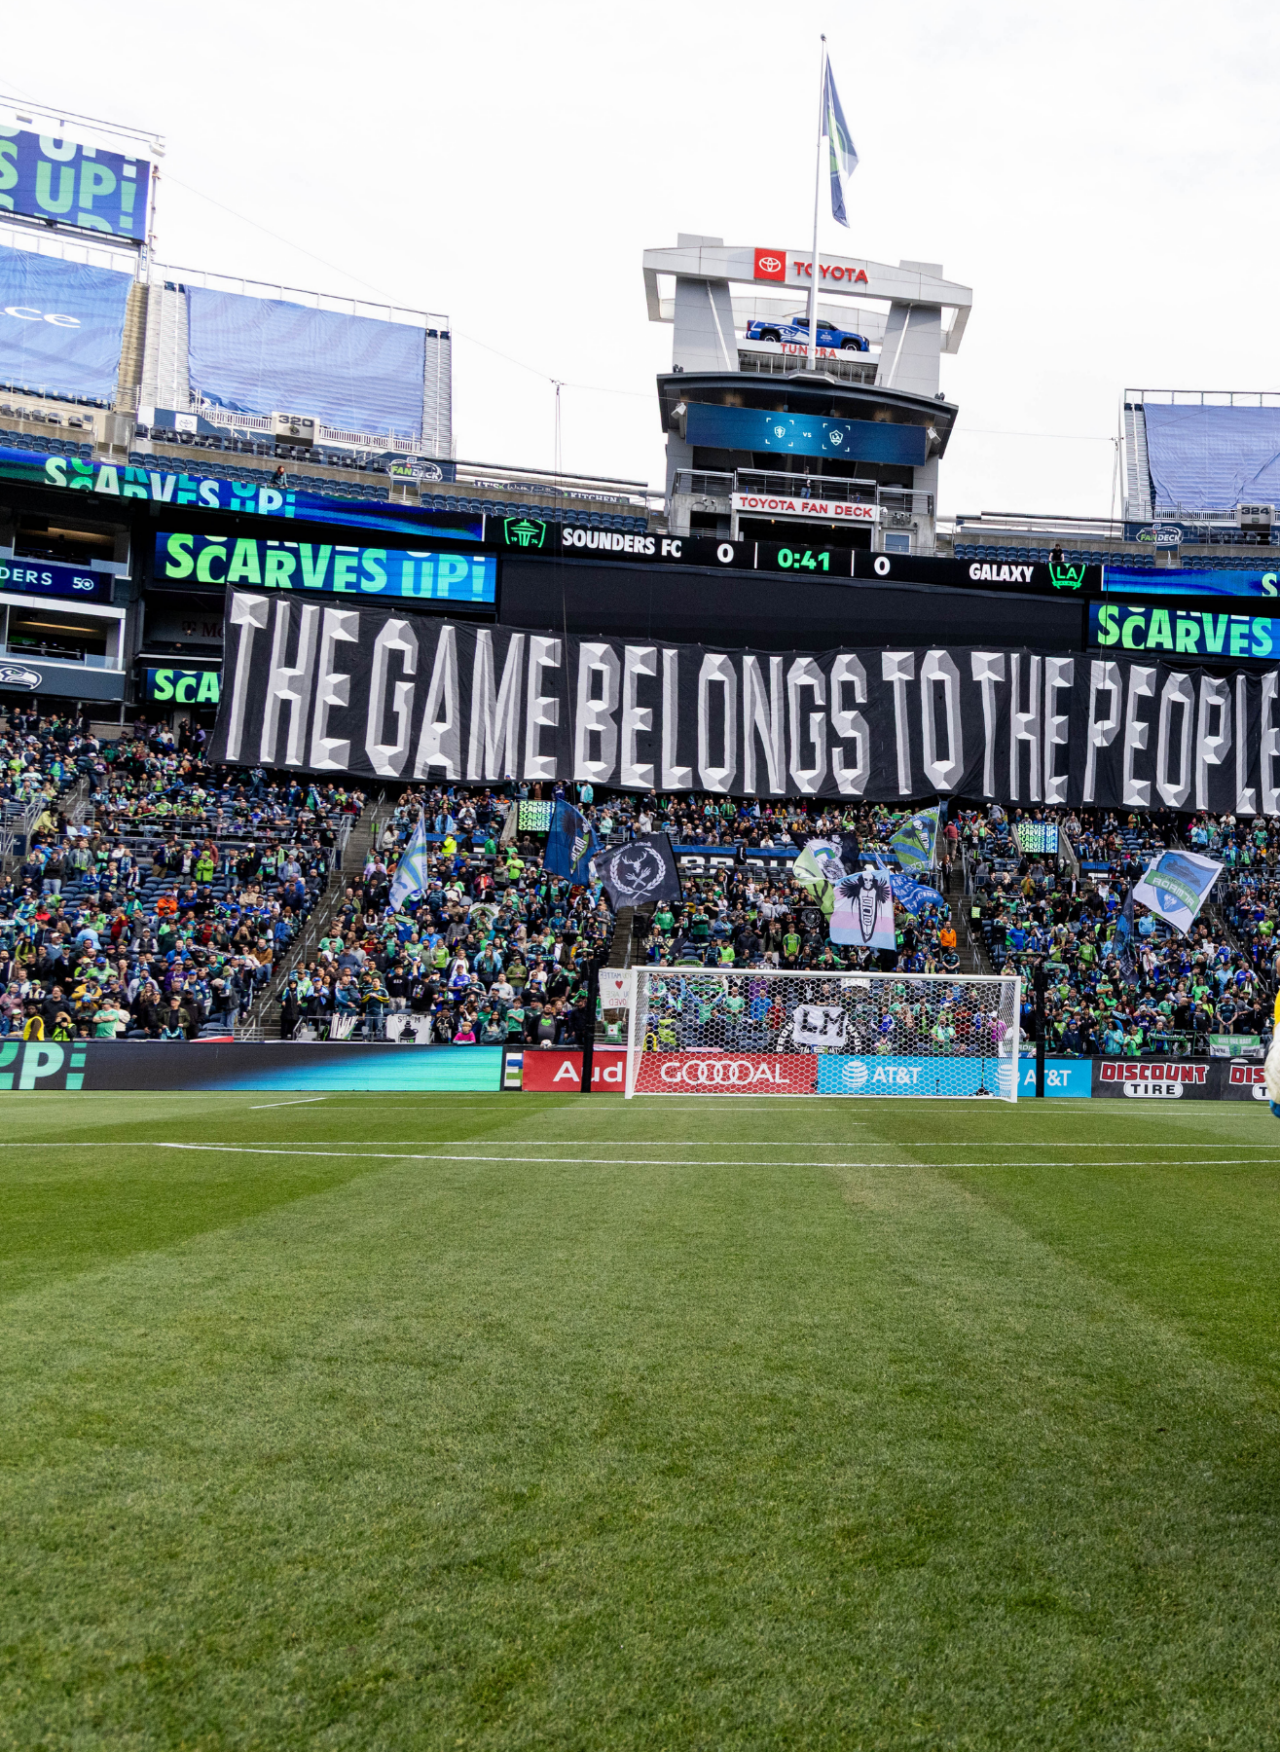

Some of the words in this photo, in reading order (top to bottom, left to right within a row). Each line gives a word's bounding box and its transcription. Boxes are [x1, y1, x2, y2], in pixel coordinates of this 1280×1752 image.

[277, 413, 315, 429] 320
[739, 496, 796, 513] TOYOTA
[801, 500, 828, 514] FAN
[834, 503, 873, 518] DECK
[1241, 506, 1270, 516] 324
[562, 528, 656, 555] SOUNDERS
[661, 538, 683, 558] FC
[717, 543, 734, 564] 0
[164, 533, 387, 593] SCARVES
[777, 548, 830, 572] 0:41
[874, 555, 891, 576] 0
[0, 567, 53, 586] DERS
[969, 562, 1034, 583] GALAXY
[1097, 605, 1274, 658] SCARVES
[229, 591, 360, 770] THE
[365, 617, 562, 781] GAME
[573, 641, 868, 797] BELONGS
[881, 649, 964, 796] TO
[971, 650, 1074, 804] THE
[871, 1065, 923, 1084] AT&T
[1100, 1062, 1208, 1085] DISCOUNT
[1130, 1083, 1176, 1096] TIRE
